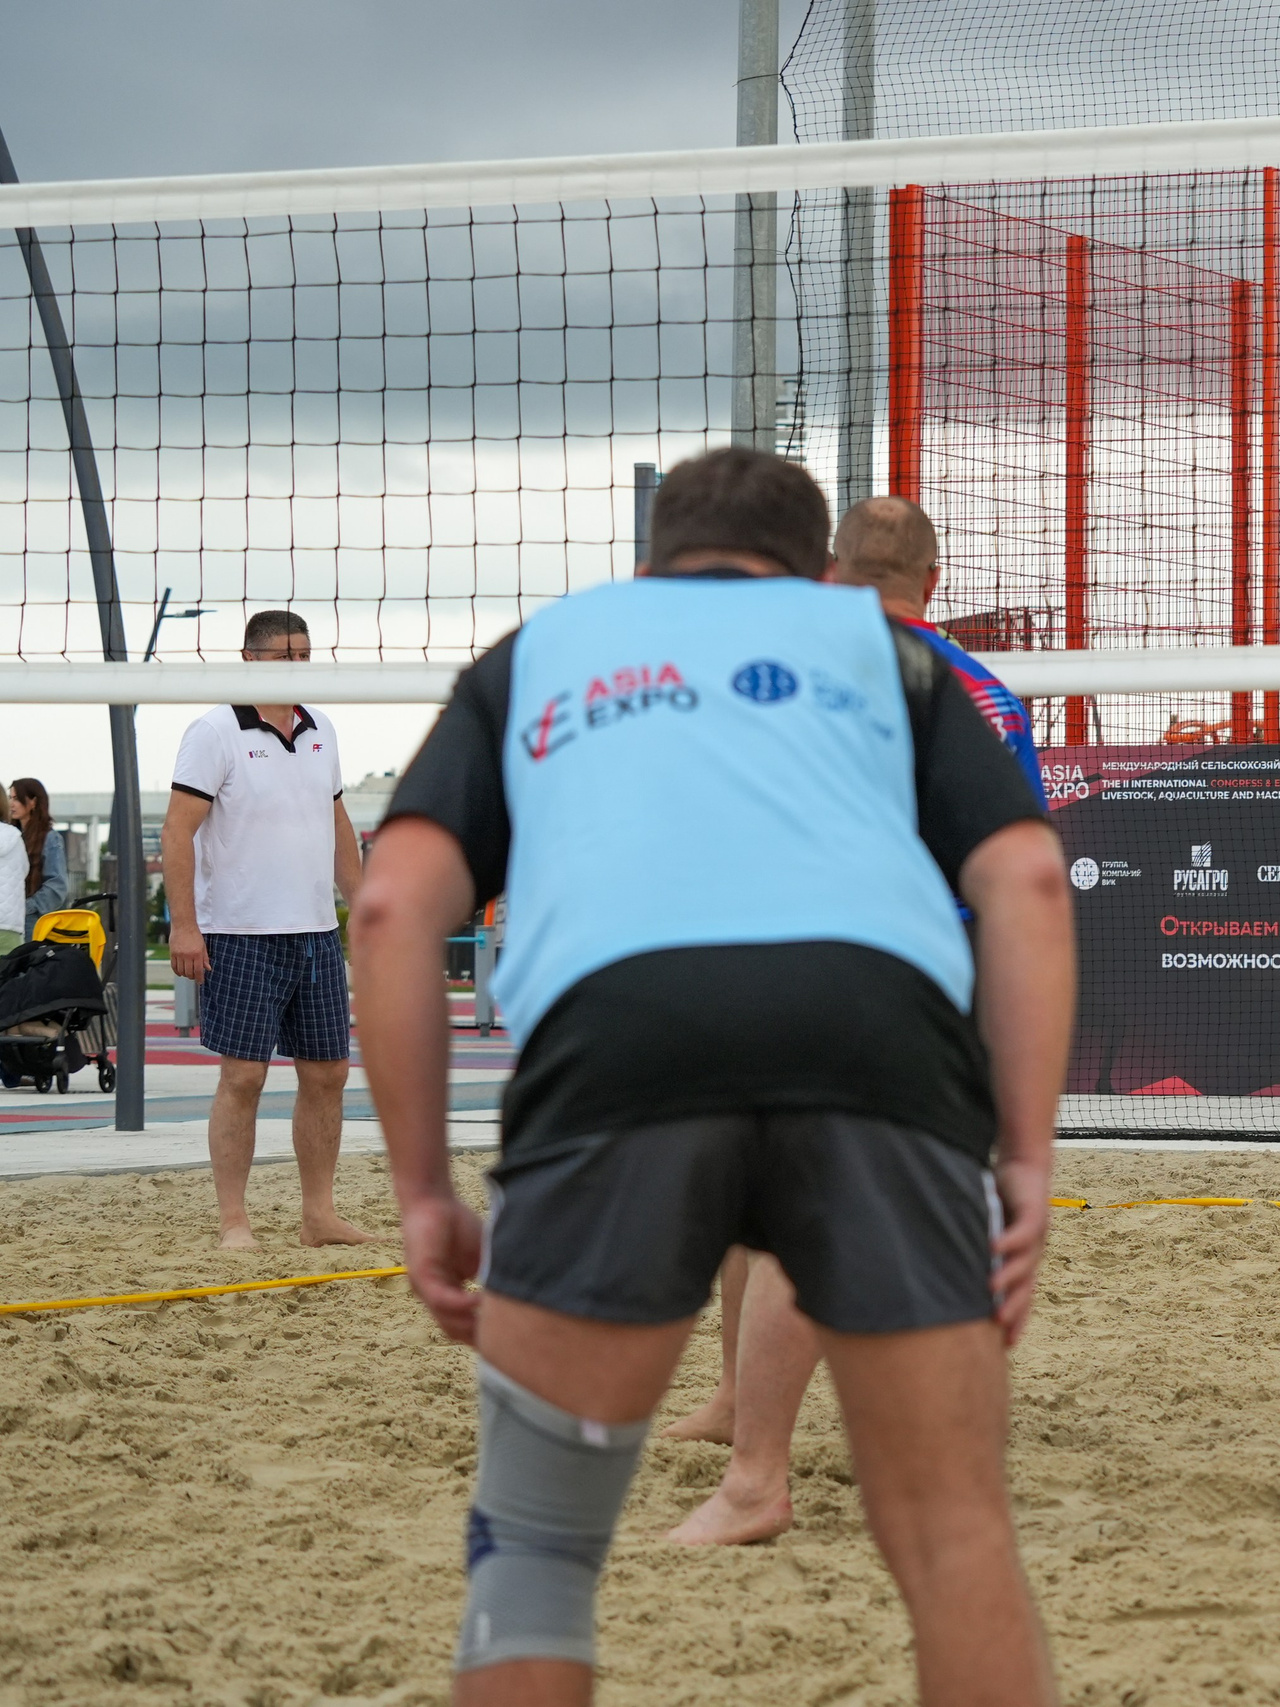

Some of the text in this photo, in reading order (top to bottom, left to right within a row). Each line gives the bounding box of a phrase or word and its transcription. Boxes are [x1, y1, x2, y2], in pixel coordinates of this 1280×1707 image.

[585, 663, 683, 703] ASIA
[586, 686, 698, 729] EXPO
[1102, 760, 1199, 771] МЕЖДУНАРОДНЫЙ
[1041, 765, 1084, 781] ASIA
[1102, 780, 1120, 788] THE
[1123, 779, 1129, 788] II
[1131, 779, 1207, 788] INTERNATIONAL
[1210, 779, 1263, 788] CONGRESS
[1265, 779, 1271, 787] &
[1102, 791, 1156, 801] LIVESTOCK,
[1158, 791, 1229, 800] AQUACULTURE
[1231, 791, 1254, 799] AND
[1102, 869, 1142, 877] КОМПАНИЙ
[1173, 869, 1229, 891] РУСАГРО
